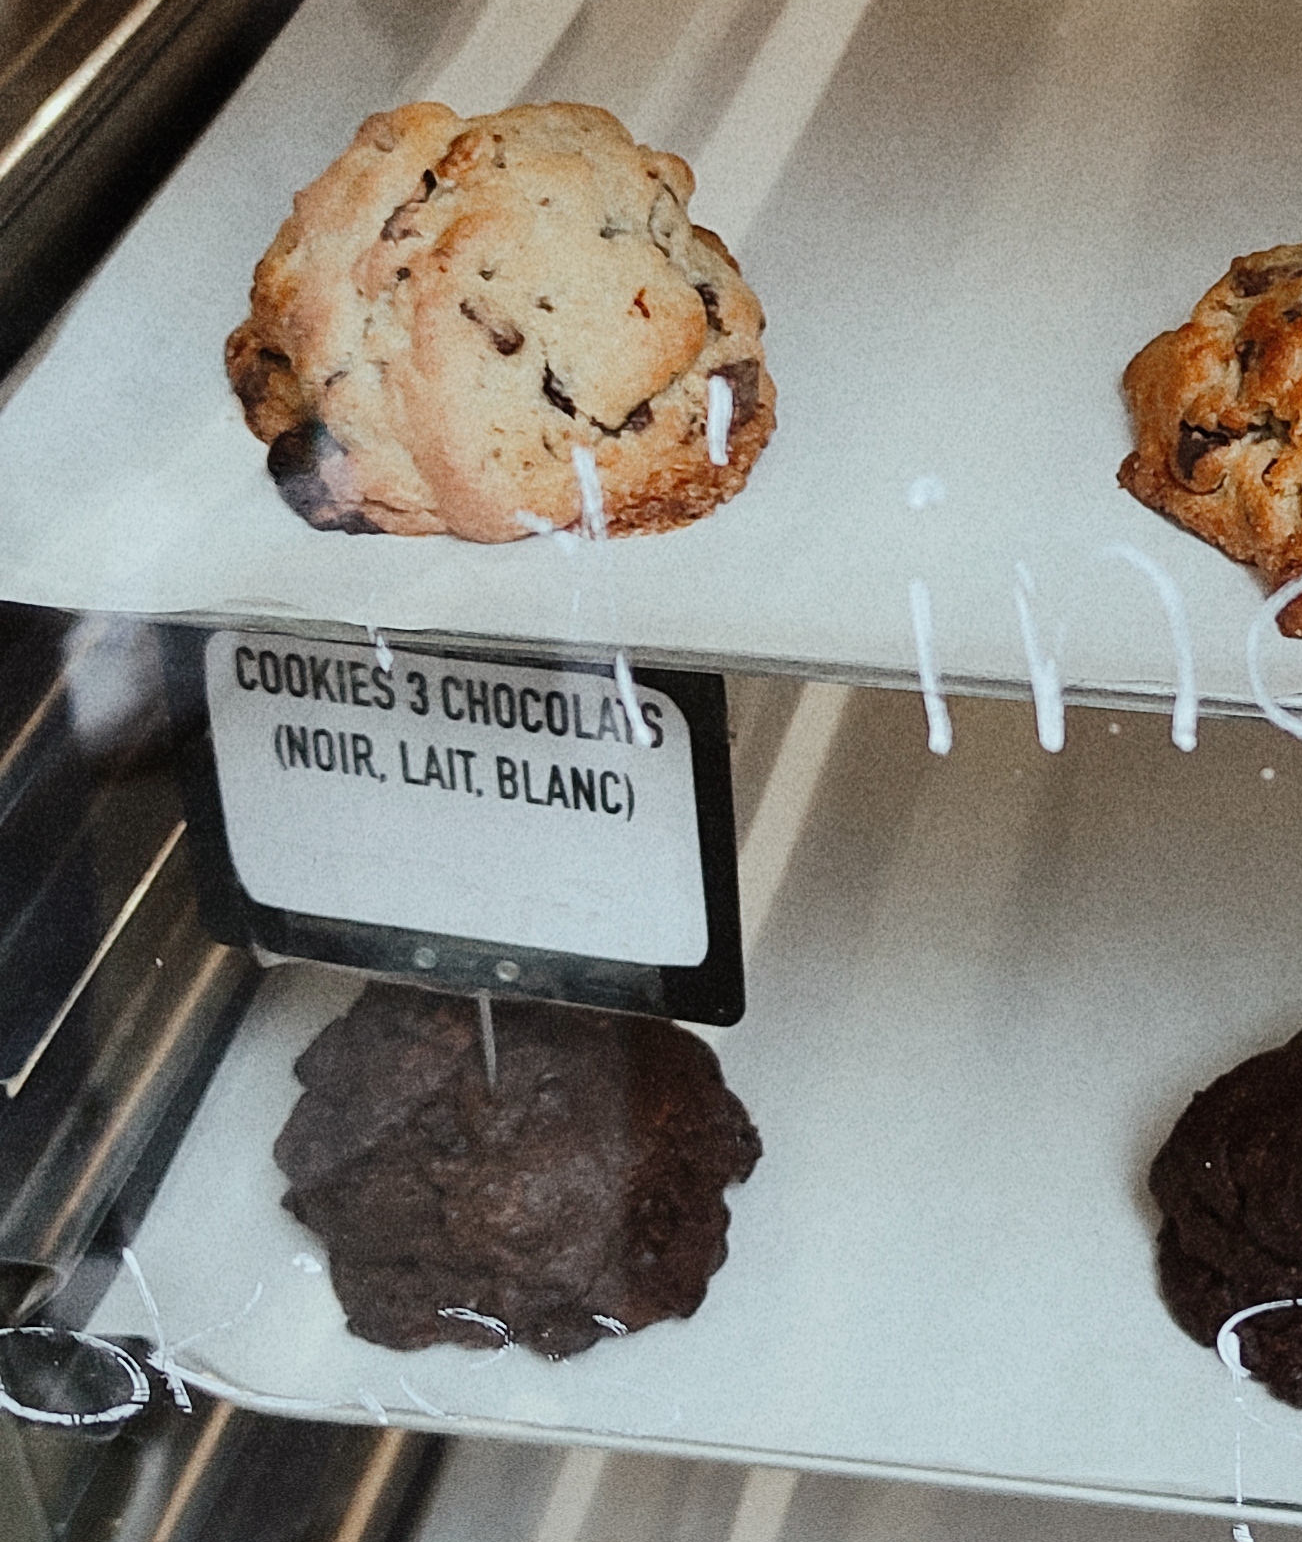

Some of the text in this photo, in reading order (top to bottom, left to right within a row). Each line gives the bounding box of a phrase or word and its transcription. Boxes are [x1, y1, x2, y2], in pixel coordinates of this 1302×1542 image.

[234, 646, 396, 712] COOKIES
[406, 671, 430, 716] 3
[498, 756, 636, 822] BLANC)
